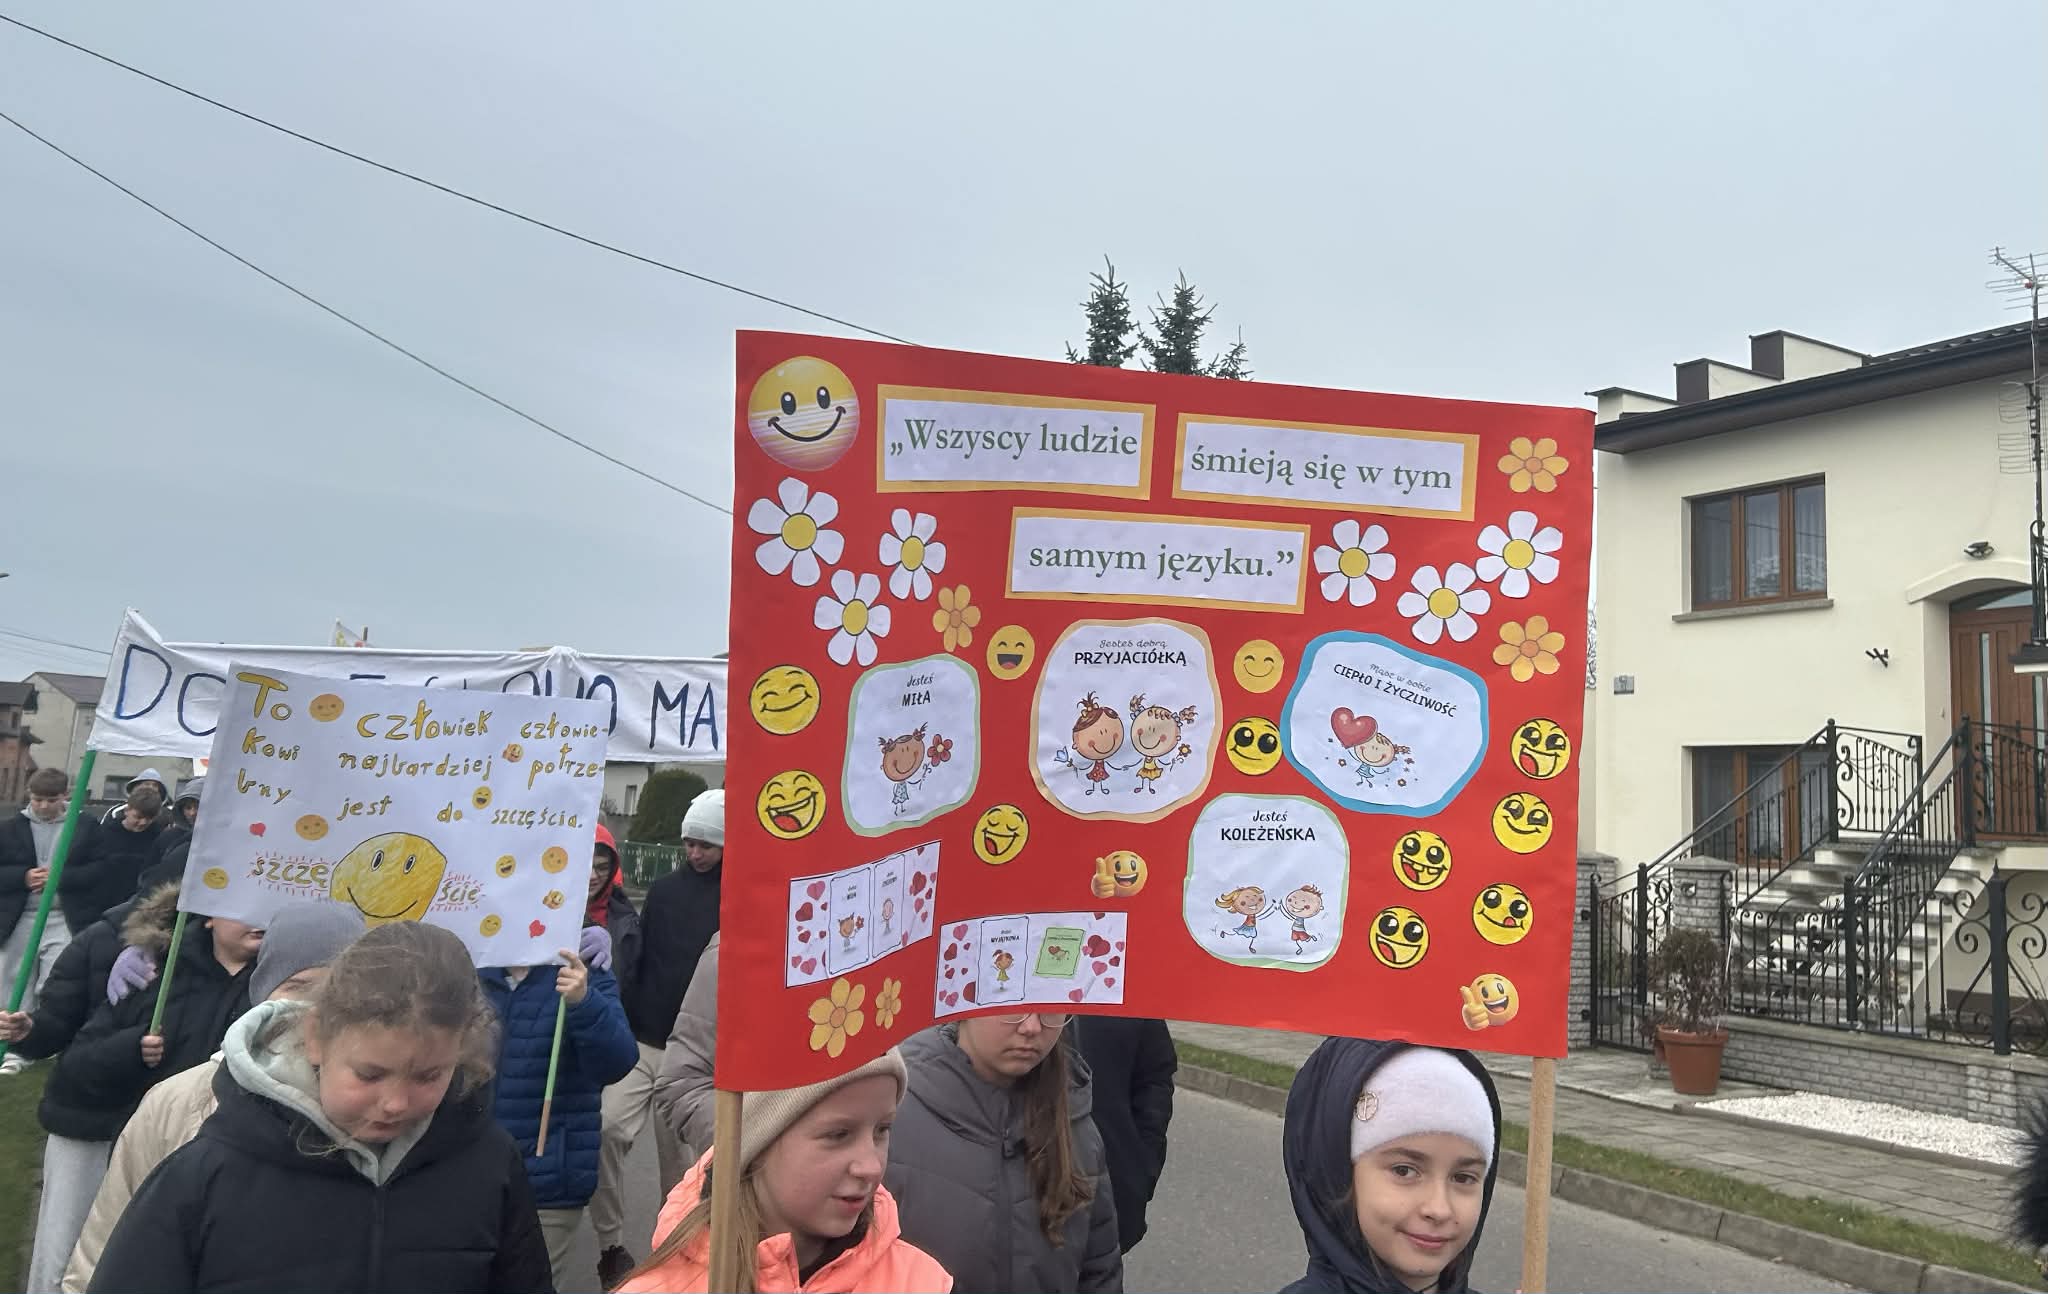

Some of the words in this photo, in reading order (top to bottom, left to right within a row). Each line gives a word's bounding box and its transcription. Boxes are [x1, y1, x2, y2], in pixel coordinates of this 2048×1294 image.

[890, 418, 1032, 461] „Wszyscy
[1039, 423, 1139, 456] ludzie
[1190, 445, 1295, 486] śmieją
[1303, 454, 1346, 489] się
[1357, 466, 1383, 484] w
[1393, 465, 1453, 495] tym
[1029, 546, 1147, 578] samym
[1156, 543, 1295, 583] języku.”
[1074, 647, 1187, 667] PRZYJACIÓŁKĄ
[906, 672, 935, 688] Jesteś
[1333, 663, 1373, 686] CIEPŁO
[1374, 679, 1382, 689] I
[1383, 681, 1457, 718] ŻYCZLIWOŚĆ
[235, 671, 293, 721] To
[520, 711, 608, 740] człowie-
[902, 690, 931, 707] MIŁA
[649, 680, 719, 752] MA
[338, 752, 493, 781] najbardziej
[335, 794, 393, 821] jest
[436, 801, 463, 823] do
[1252, 809, 1289, 823] Jesteś
[1220, 824, 1316, 841] KOLEŻEŃSKA
